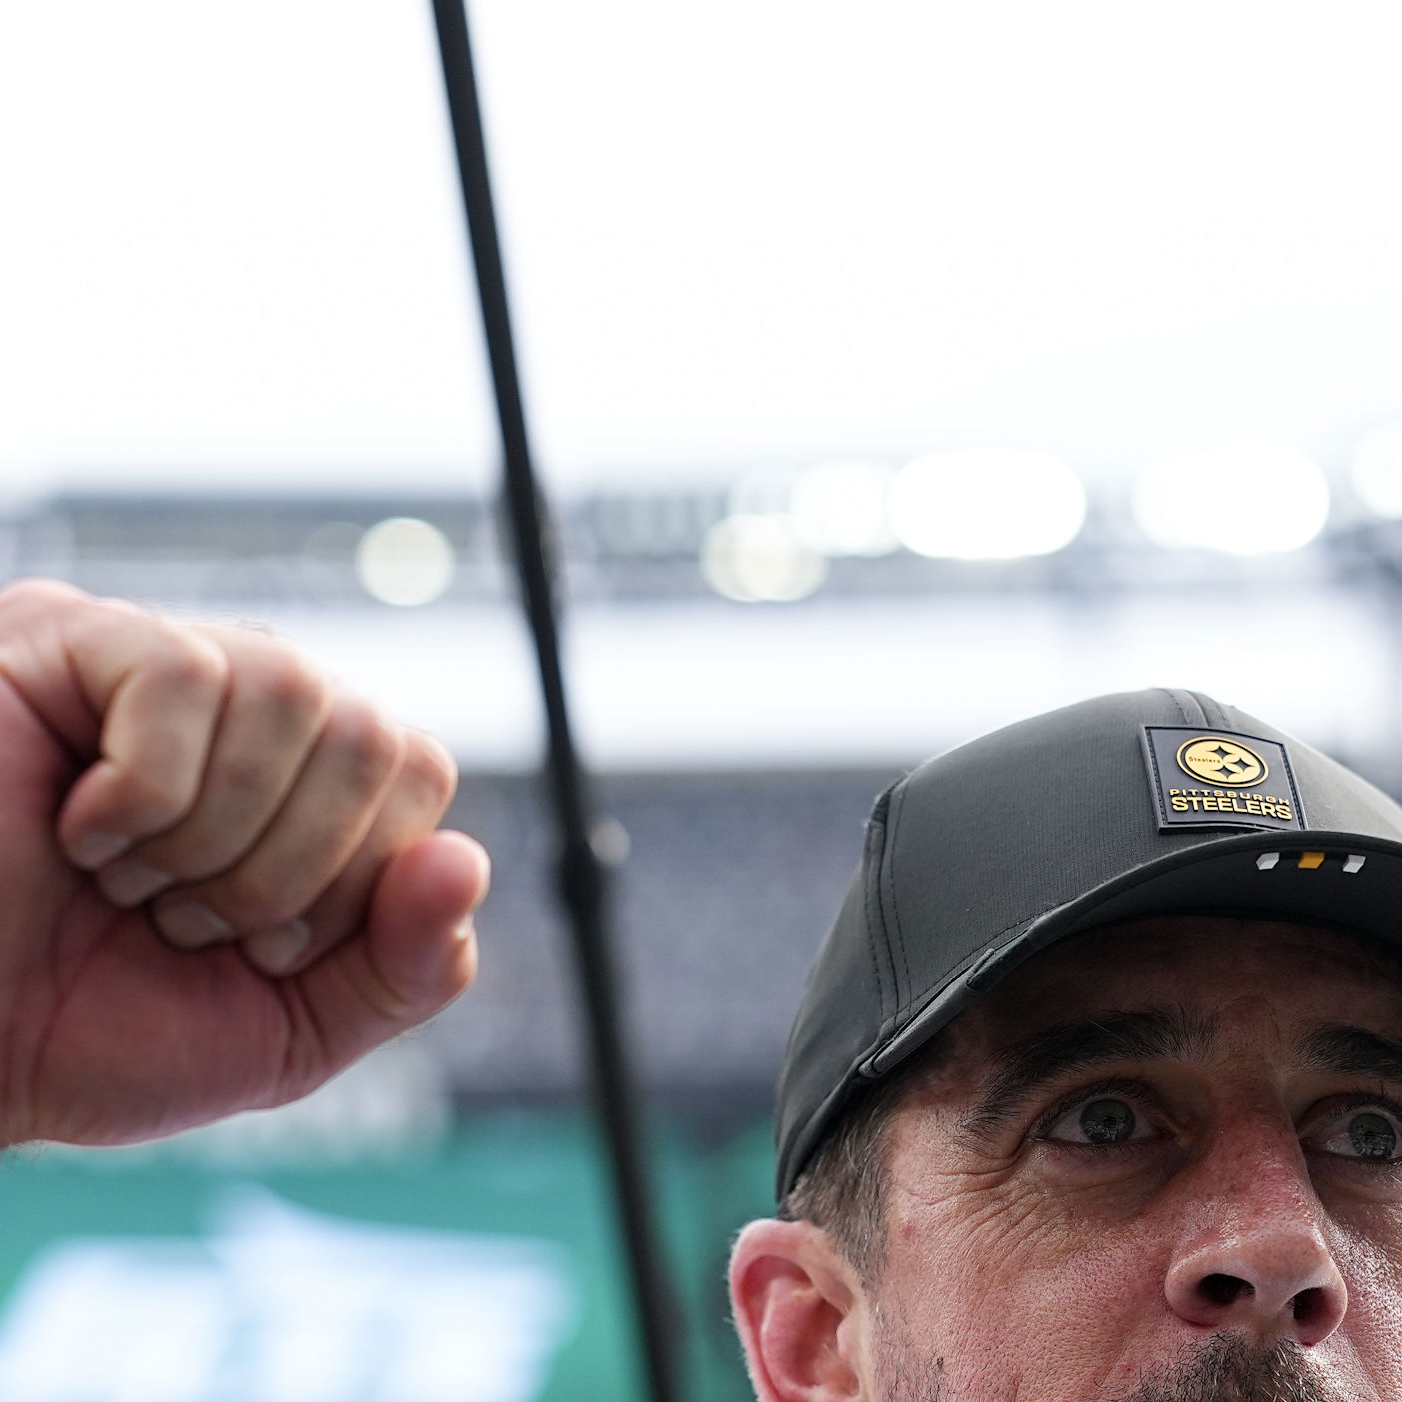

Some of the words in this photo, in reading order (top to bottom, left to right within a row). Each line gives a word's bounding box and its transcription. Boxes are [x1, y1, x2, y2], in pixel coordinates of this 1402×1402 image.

[1188, 756, 1221, 764] Steelers
[1169, 788, 1290, 806] PITTSBURGH
[1171, 796, 1293, 820] STEELERS
